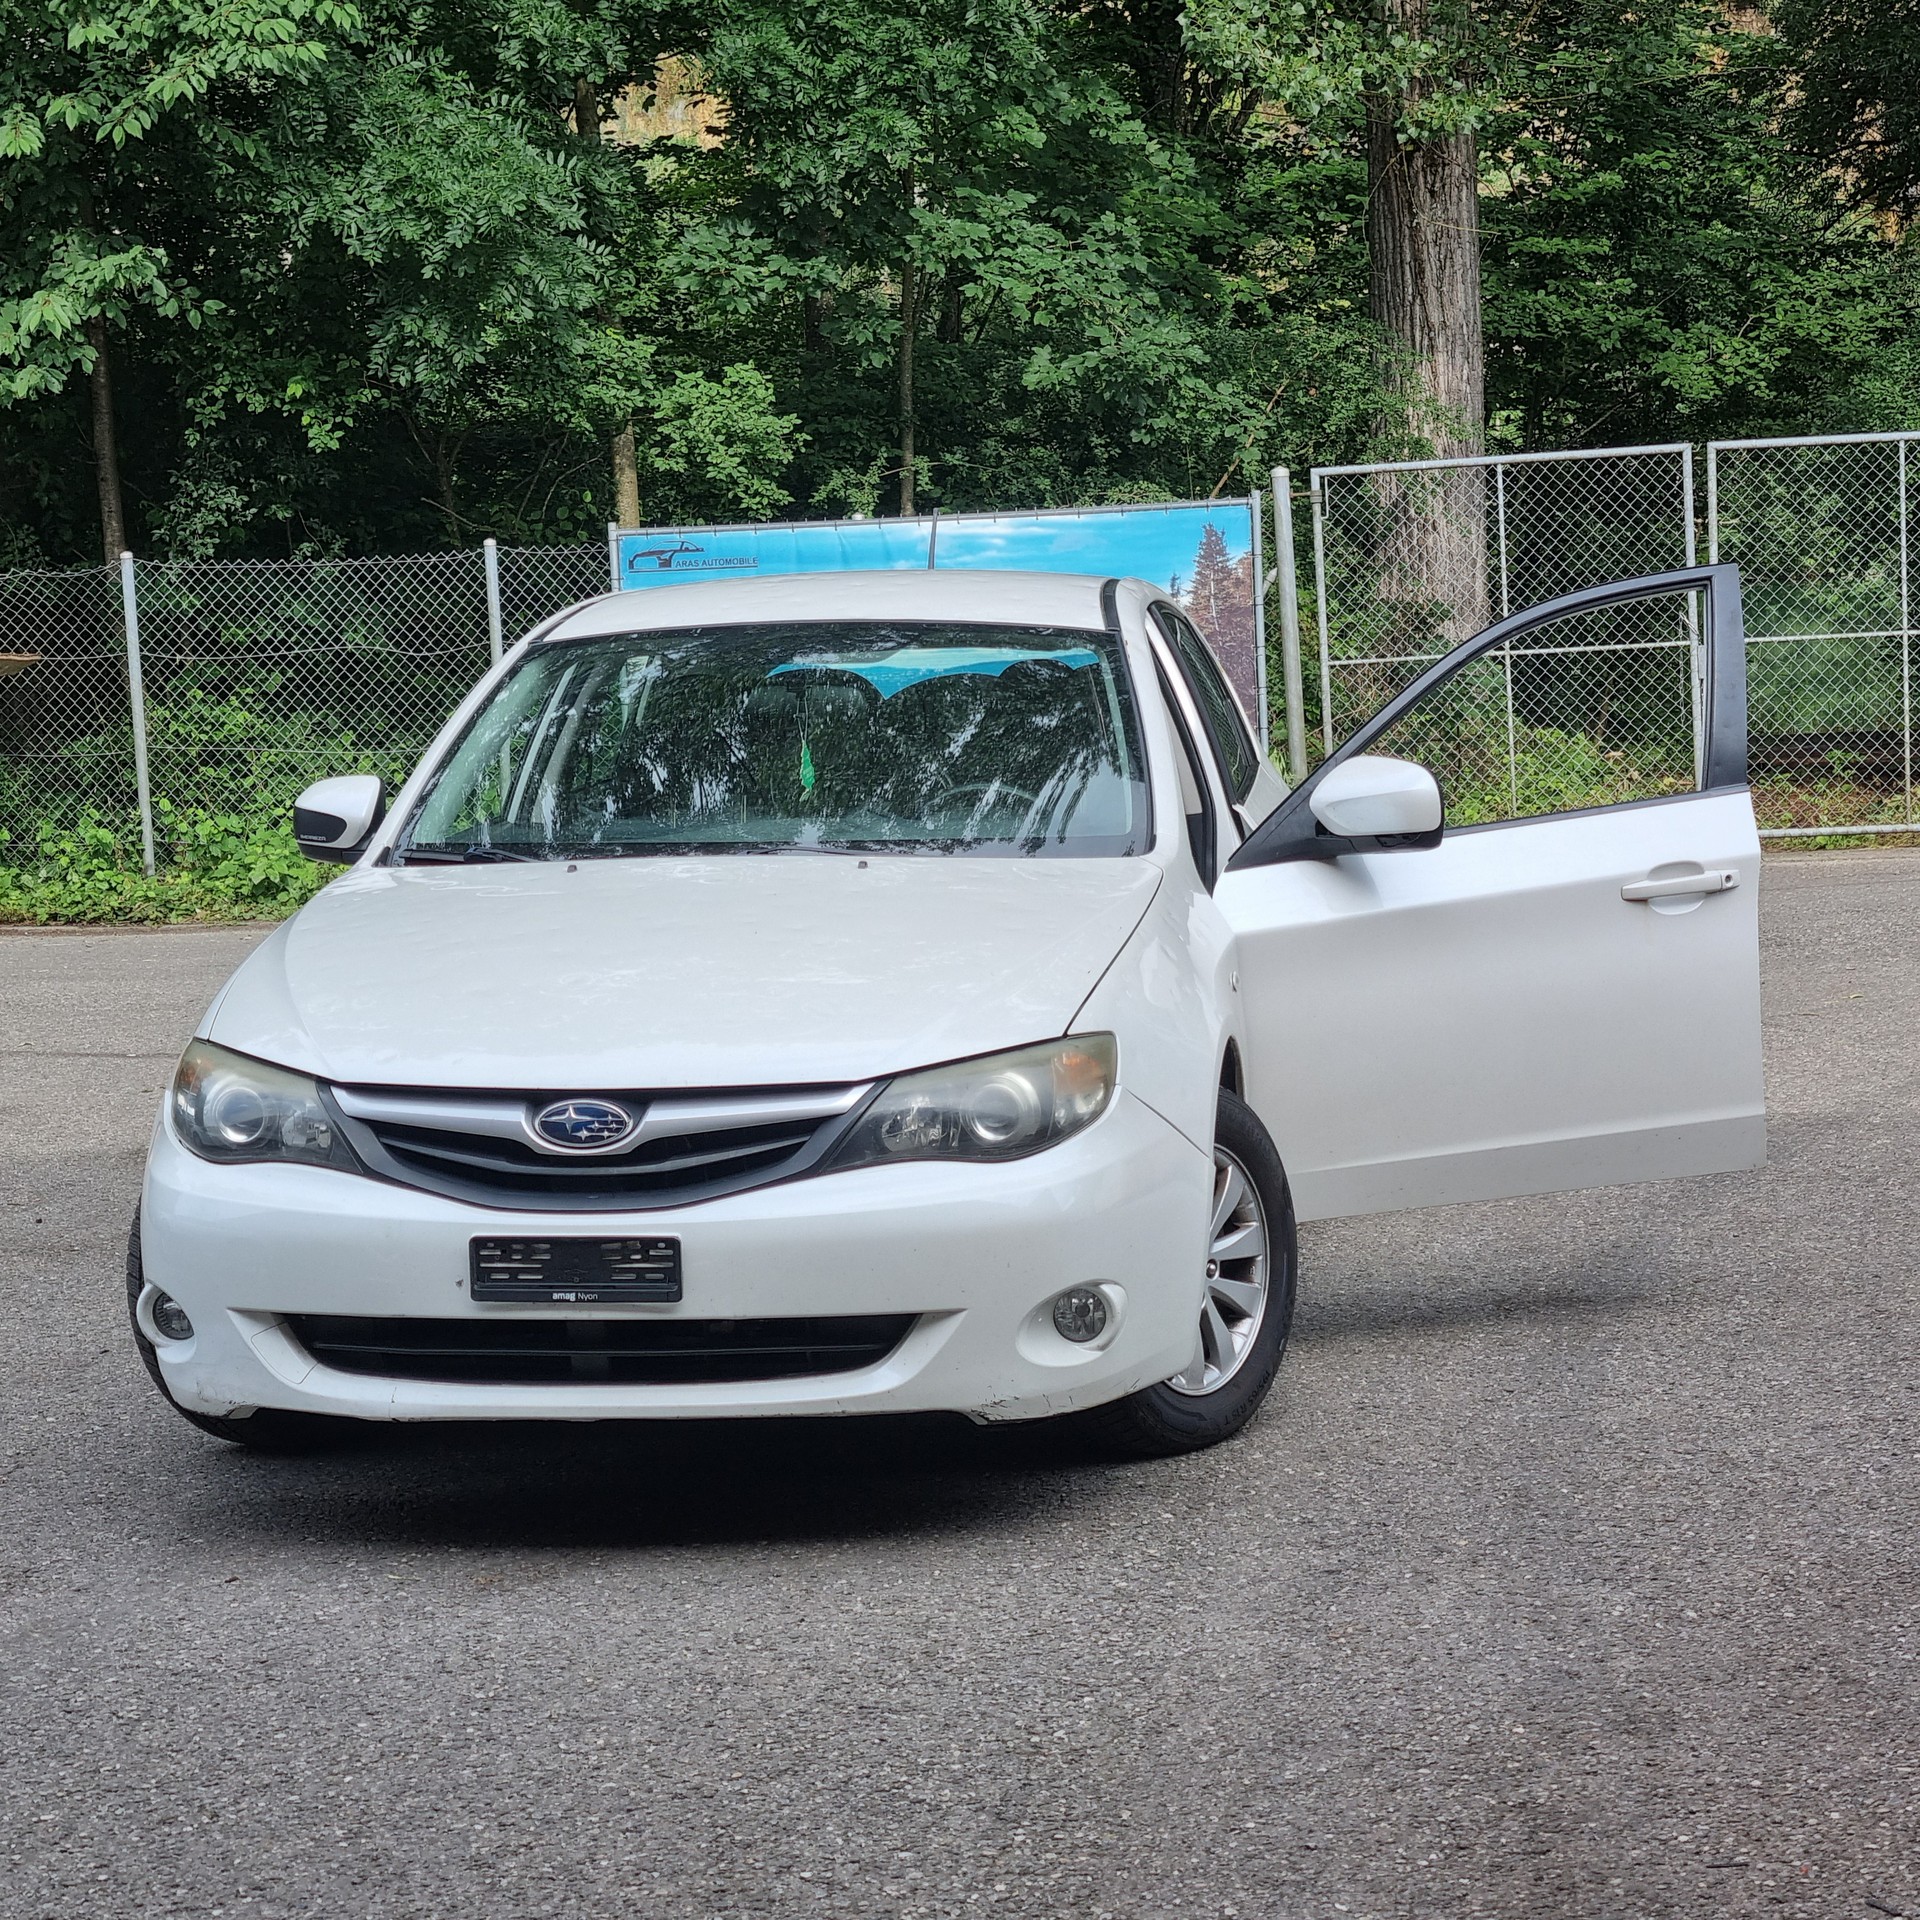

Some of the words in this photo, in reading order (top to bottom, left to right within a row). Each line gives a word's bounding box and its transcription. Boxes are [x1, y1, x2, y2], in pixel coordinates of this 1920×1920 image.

[675, 559, 699, 568] ARAS
[701, 557, 758, 567] AUTOMOBILE
[552, 1292, 575, 1302] amag
[577, 1292, 598, 1301] Nyon
